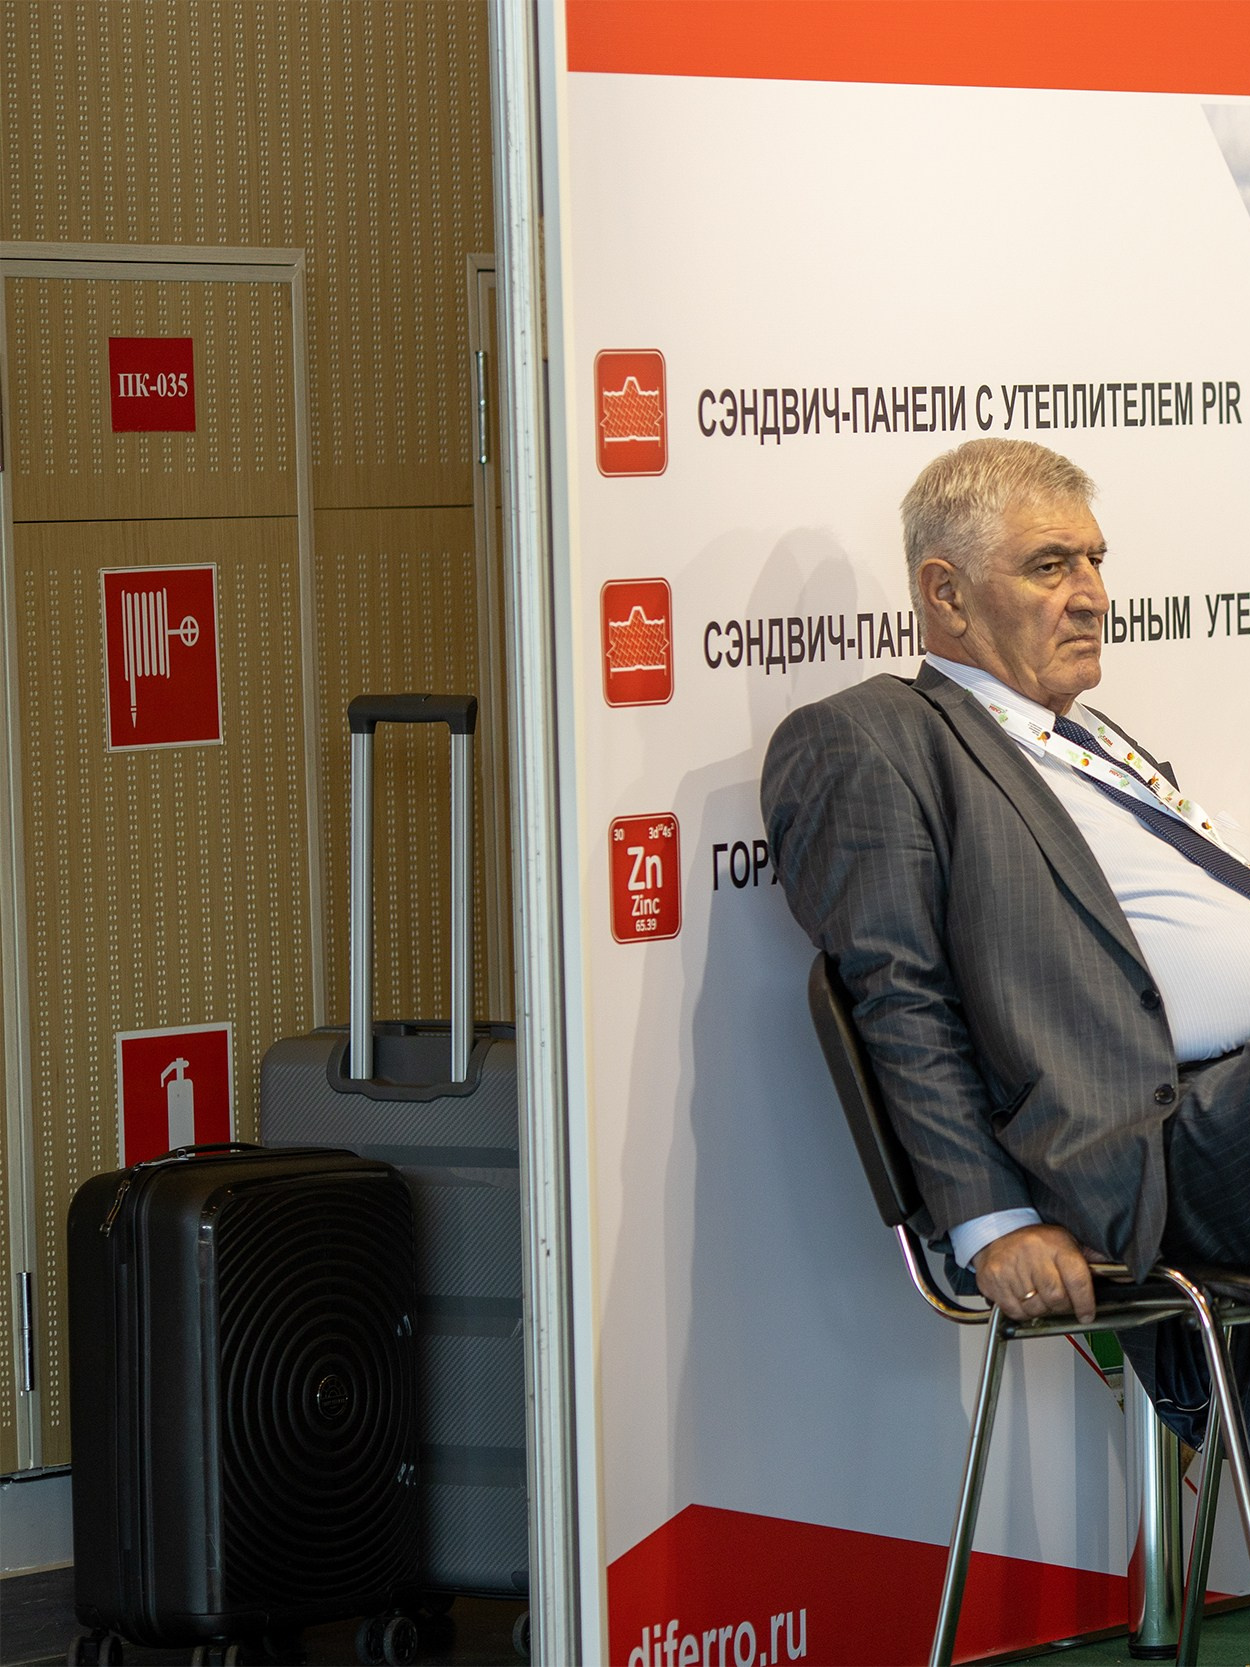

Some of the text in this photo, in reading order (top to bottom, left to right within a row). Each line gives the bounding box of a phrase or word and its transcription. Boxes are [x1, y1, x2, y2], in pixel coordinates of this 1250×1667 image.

[117, 372, 189, 398] ПК-035
[698, 381, 1243, 446] СЭНДВИЧ-ПАНЕЛИ С УТЕПЛИТЕЛЕМ PIR
[613, 828, 625, 841] 30
[627, 846, 663, 892] Zn
[712, 839, 779, 891] ГОР
[631, 894, 661, 917] Zinc
[635, 918, 657, 932] 65.39
[628, 1608, 807, 1667] diferro.ru
